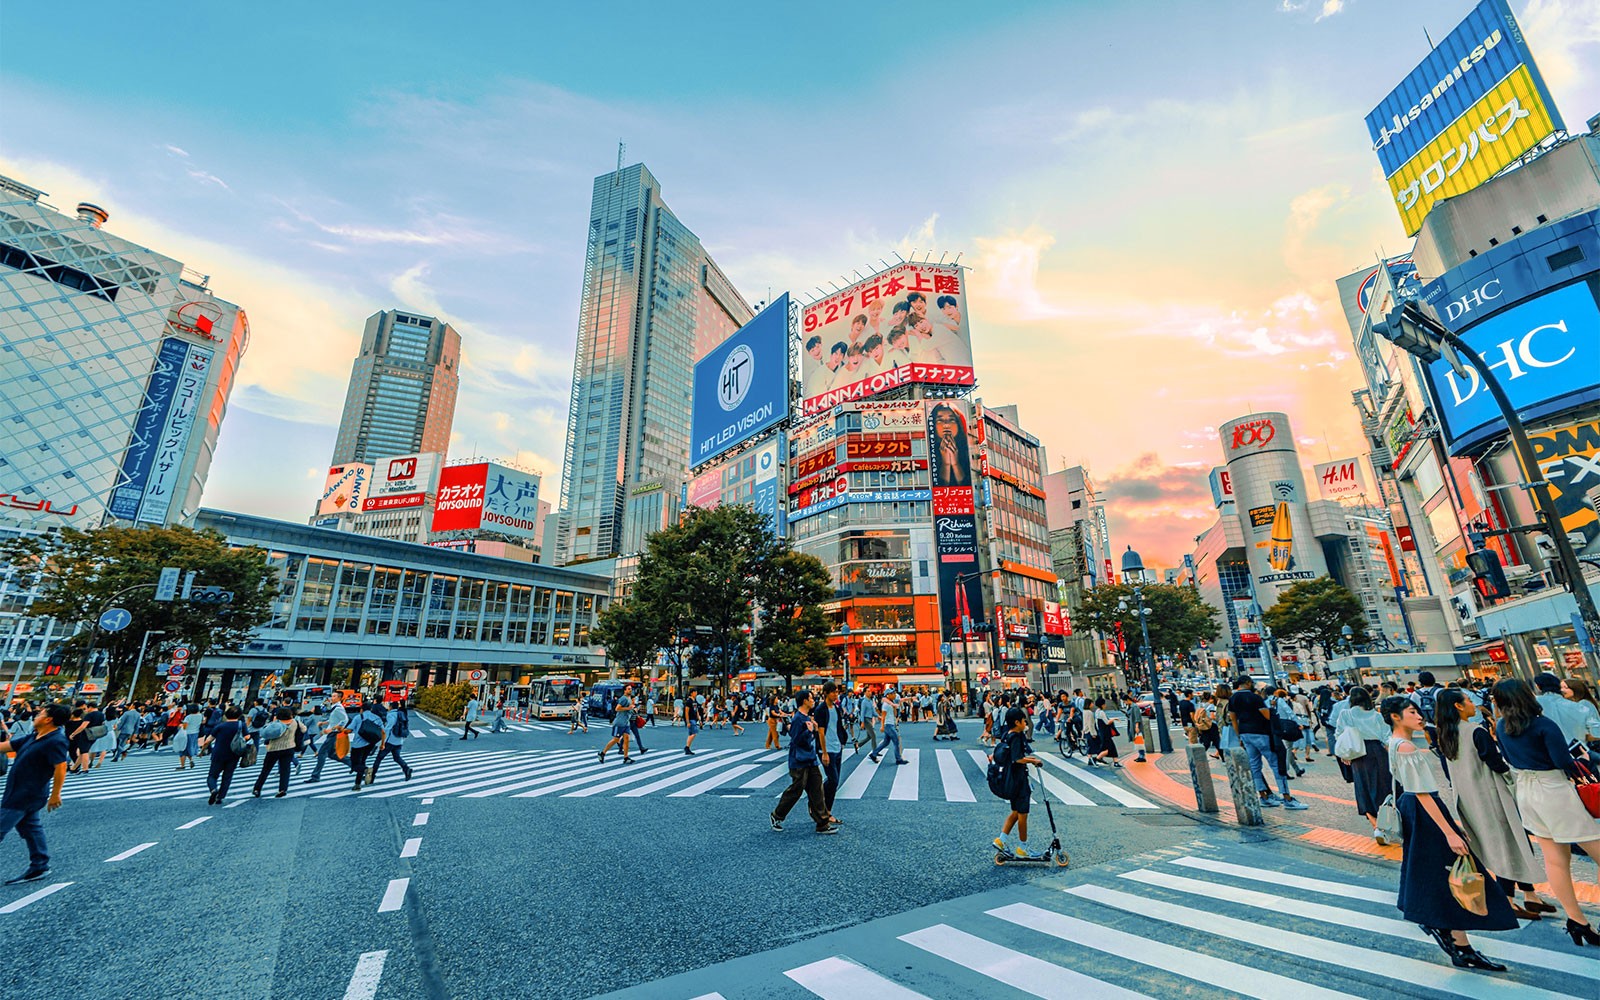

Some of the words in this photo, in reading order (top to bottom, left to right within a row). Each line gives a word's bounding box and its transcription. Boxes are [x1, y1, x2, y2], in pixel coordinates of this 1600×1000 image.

[1372, 28, 1502, 151] Hisamitsu
[1397, 97, 1530, 211] サロンパス
[804, 296, 854, 333] 9.27
[861, 272, 960, 309] 日本上陸
[1445, 278, 1503, 323] DHC
[1444, 319, 1576, 407] DHC
[914, 366, 971, 381] ワナワン
[854, 400, 920, 410] しゃぶしゃぶバイキング
[883, 412, 922, 426] しゃぶ葉
[1234, 419, 1272, 431] SHIBUYA
[149, 377, 197, 496] ワコールビッグバザール
[700, 435, 715, 455] HIT
[717, 424, 735, 445] LED
[737, 401, 773, 432] VISION
[1231, 425, 1275, 449] 109
[847, 442, 910, 454] コンタクト
[389, 459, 415, 478] DC
[891, 461, 921, 472] ガスト
[1323, 462, 1355, 485] H&M
[1538, 451, 1600, 484] FX
[819, 468, 840, 483] ガスト
[323, 469, 354, 500] SANKYO
[349, 467, 366, 508] SANKYO
[388, 484, 417, 493] MasterCard
[439, 483, 484, 500] カラオケ
[489, 474, 538, 502] 大声
[933, 487, 972, 499] ユリゴコロ
[1328, 486, 1351, 494] 150m
[810, 485, 834, 505] ガスト
[875, 491, 930, 500] 英会話イーオン
[437, 498, 483, 511] JOYSOUND
[482, 511, 534, 531] JOYSOUND
[936, 517, 973, 532] Rihwa
[1259, 571, 1315, 582] MAYBELLINE
[863, 634, 907, 643] L'OCCITANE
[1047, 646, 1066, 659] LUSH
